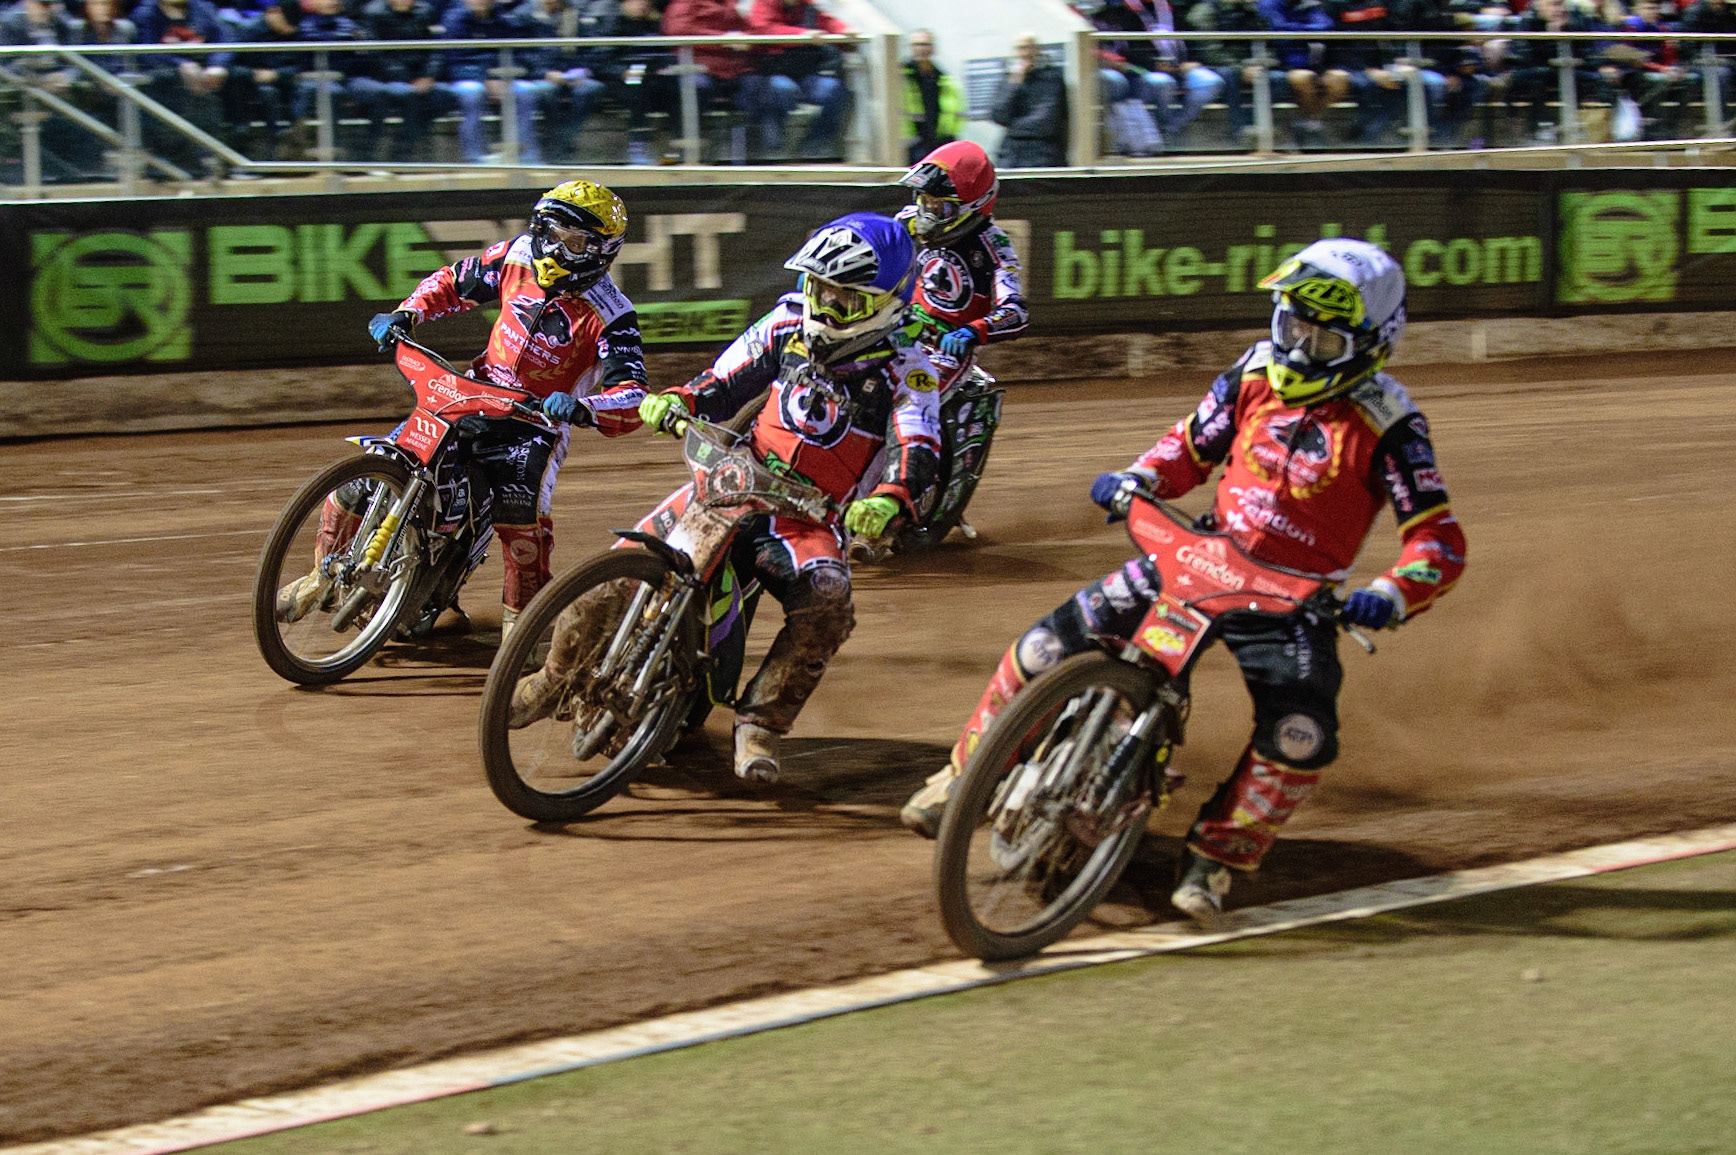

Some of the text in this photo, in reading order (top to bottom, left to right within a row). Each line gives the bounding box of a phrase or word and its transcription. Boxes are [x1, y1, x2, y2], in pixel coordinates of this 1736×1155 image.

[500, 321, 561, 365] PANTHERS
[427, 378, 468, 405] Crendon
[405, 437, 429, 452] MARINE
[409, 430, 432, 446] WESSEX
[1175, 544, 1246, 591] Crendon
